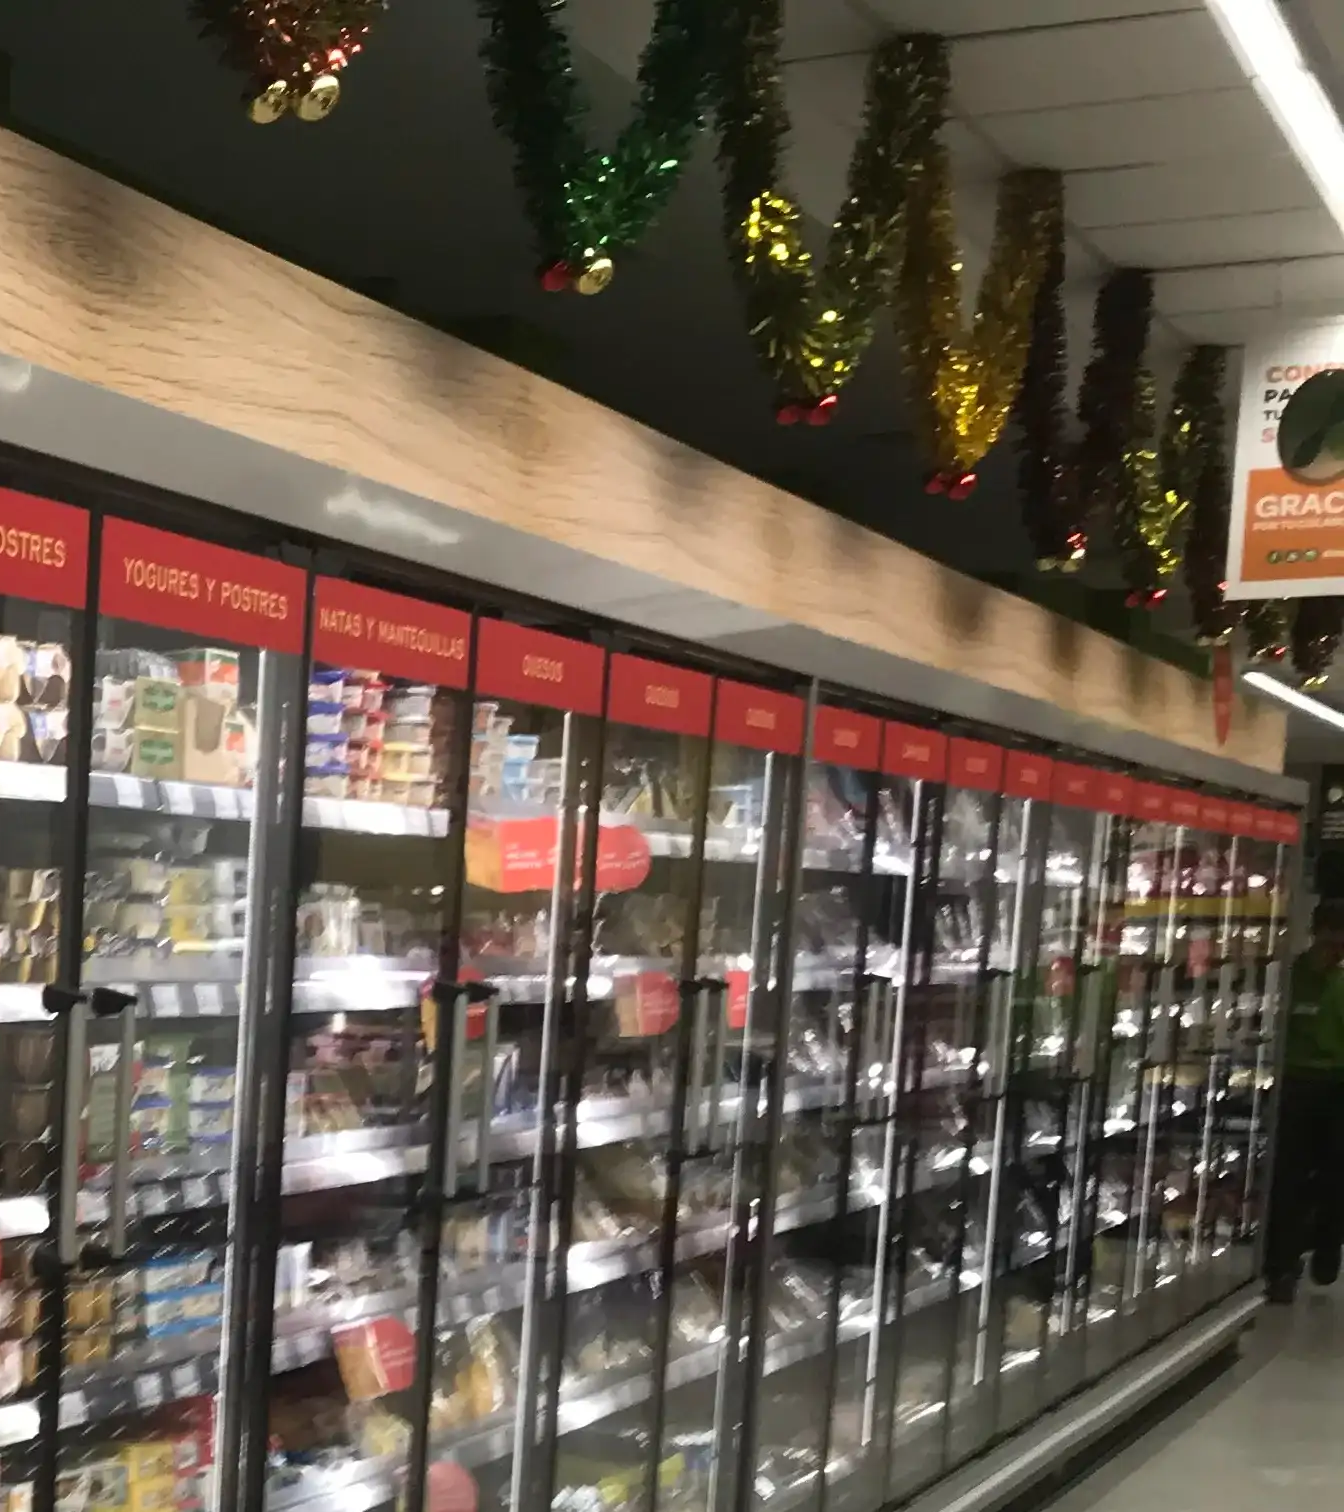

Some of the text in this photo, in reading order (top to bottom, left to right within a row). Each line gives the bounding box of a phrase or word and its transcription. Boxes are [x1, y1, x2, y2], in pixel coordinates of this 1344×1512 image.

[123, 557, 288, 621] YOGURES Y POSTRES
[319, 612, 464, 661] NATAS Y MANTEQUILLAS
